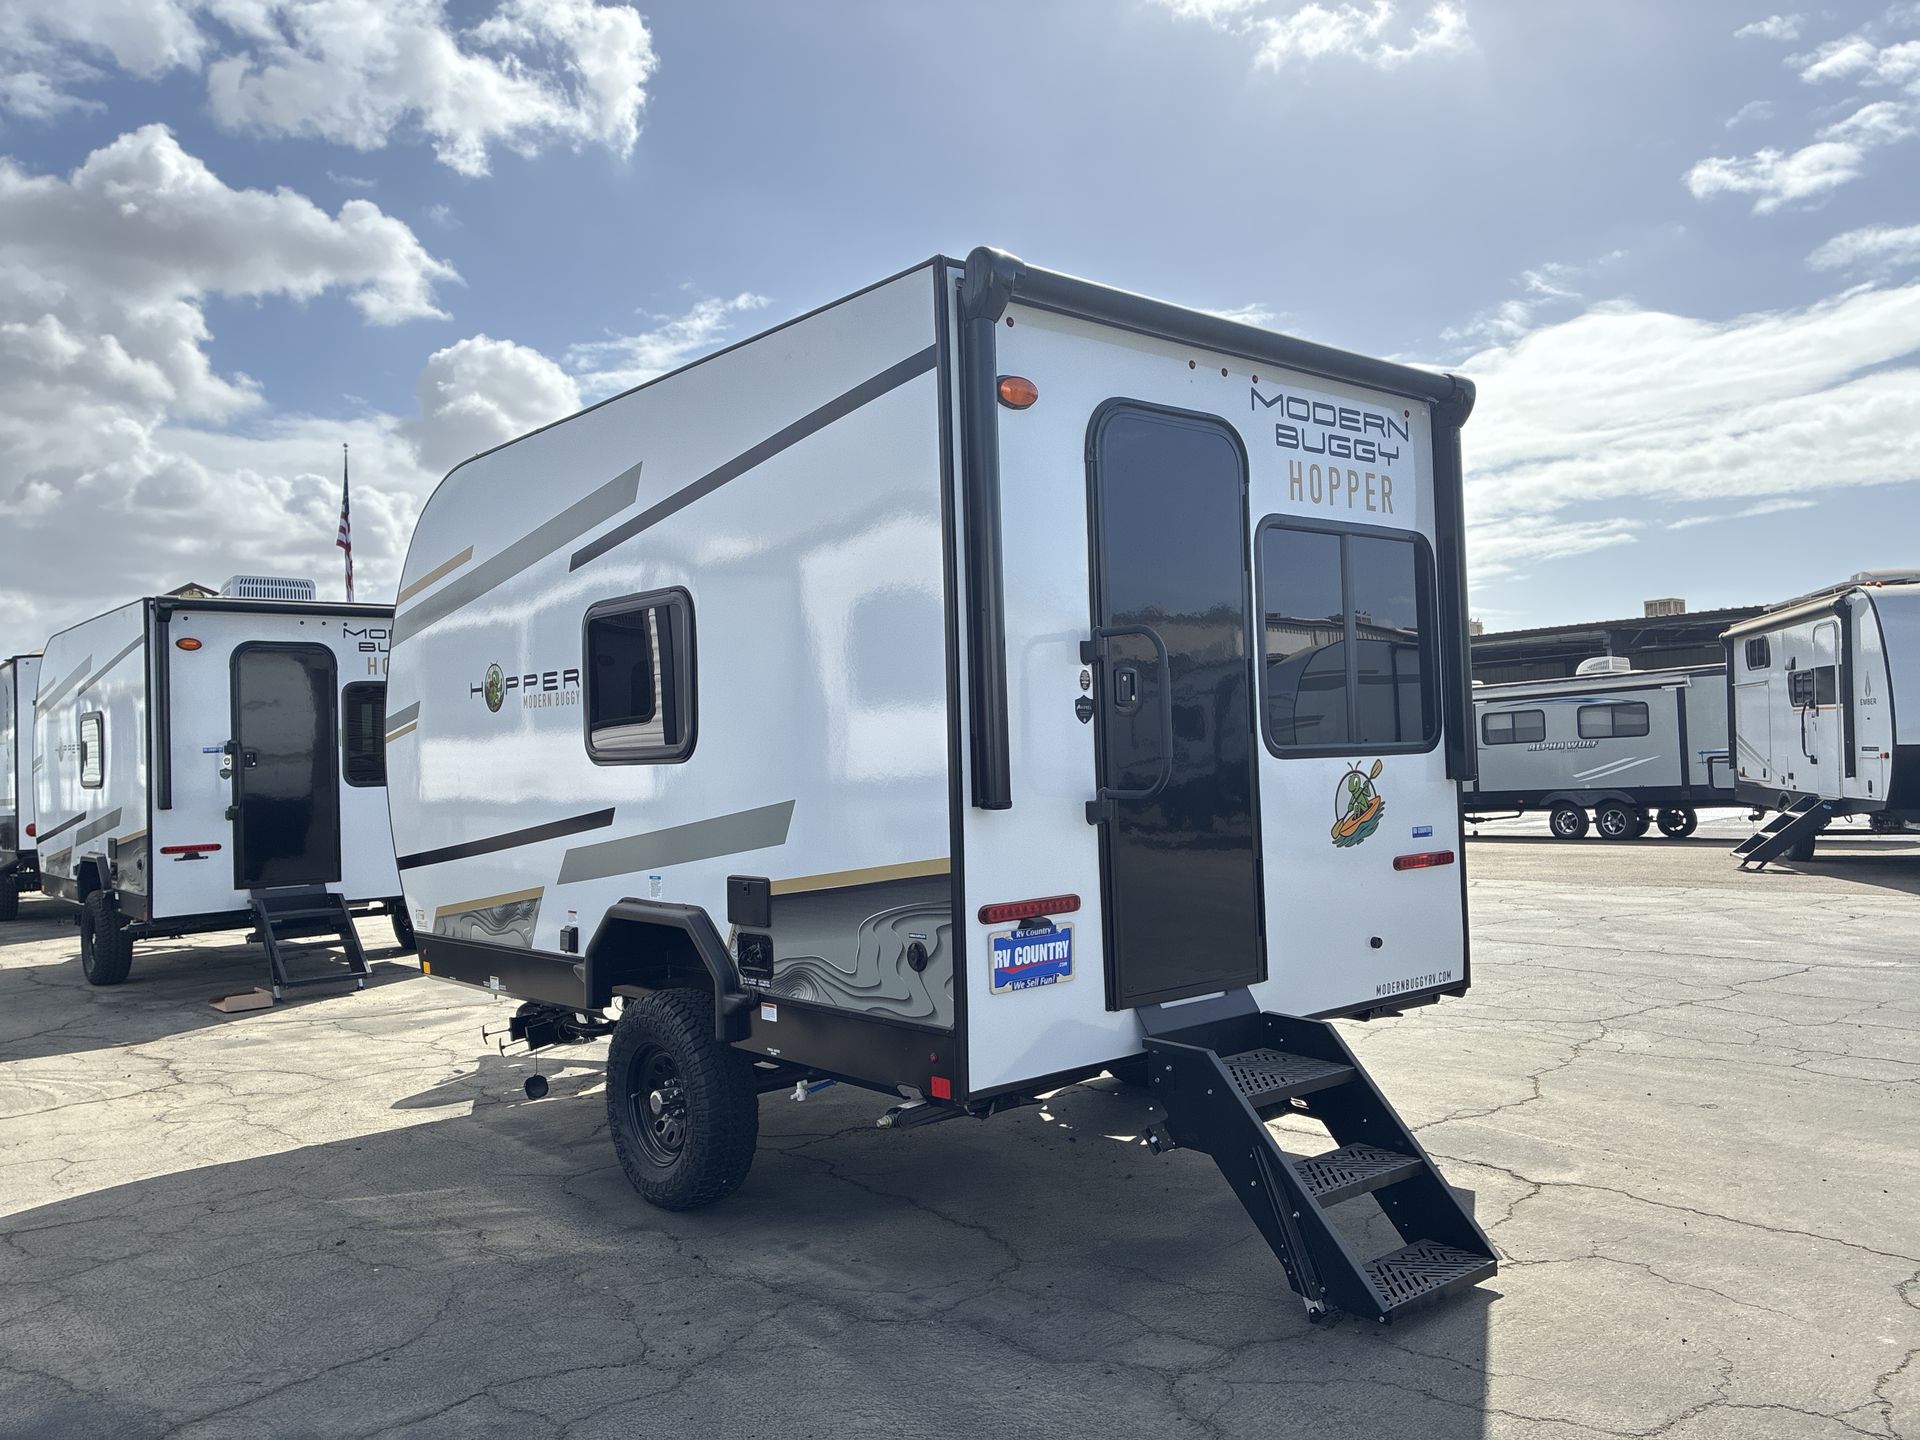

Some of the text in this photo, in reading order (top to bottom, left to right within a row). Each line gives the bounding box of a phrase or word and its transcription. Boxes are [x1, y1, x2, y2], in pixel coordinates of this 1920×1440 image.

[1251, 387, 1409, 442] MODERN
[1276, 423, 1399, 466] BUGGY
[1289, 459, 1393, 514] HOPPER
[523, 690, 580, 709] MODERN BUGGY
[1860, 698, 1877, 706] EMBER
[1528, 739, 1599, 751] ALPHA WOLF
[1016, 927, 1051, 938] RV Country
[994, 940, 1069, 969] RV COUNTRY
[1014, 975, 1056, 990] We Sell Fun!
[1376, 970, 1452, 996] MODERNBUGGYRV.COM
